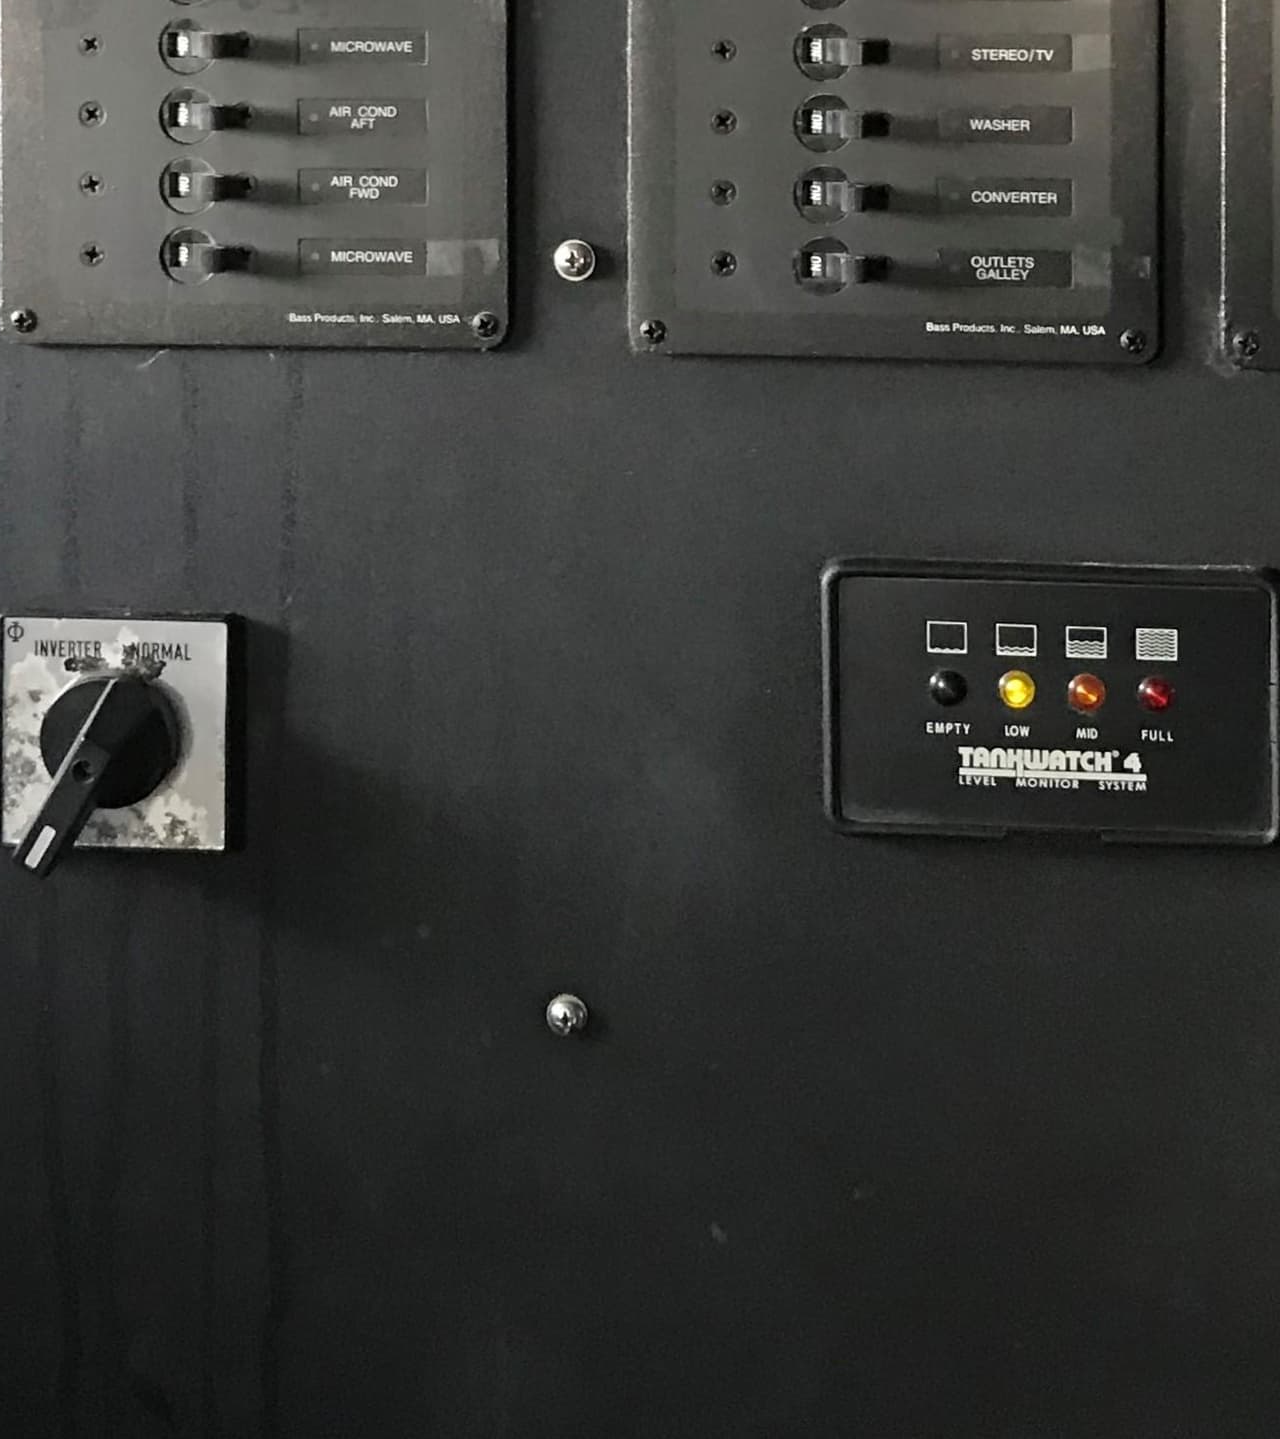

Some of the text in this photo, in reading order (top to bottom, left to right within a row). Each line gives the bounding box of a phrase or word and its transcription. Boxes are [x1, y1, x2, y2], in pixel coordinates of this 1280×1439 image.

[331, 41, 412, 53] MICROWAVE
[972, 49, 1053, 61] STEREO/TV
[330, 106, 397, 118] AIR COND
[351, 118, 375, 129] AFT
[970, 120, 1030, 131] WASHER
[331, 176, 398, 188] AIR COND
[350, 188, 379, 199] FWD
[972, 191, 1057, 204] CONVERTER
[331, 251, 412, 263] MICROWAVE
[971, 256, 1034, 268] OUTLETS
[976, 269, 1030, 280] GALLEY
[926, 322, 949, 332] Bass
[1083, 325, 1105, 335] USA
[34, 640, 192, 660] INVERTER NORMAL
[926, 722, 971, 735] EMPTY
[1004, 725, 1030, 737] LOW
[1076, 728, 1098, 740] MID
[1141, 729, 1174, 742] FULL
[1123, 752, 1142, 772] 4
[959, 776, 1147, 791] LEVEL MONITOR SYSTEM
